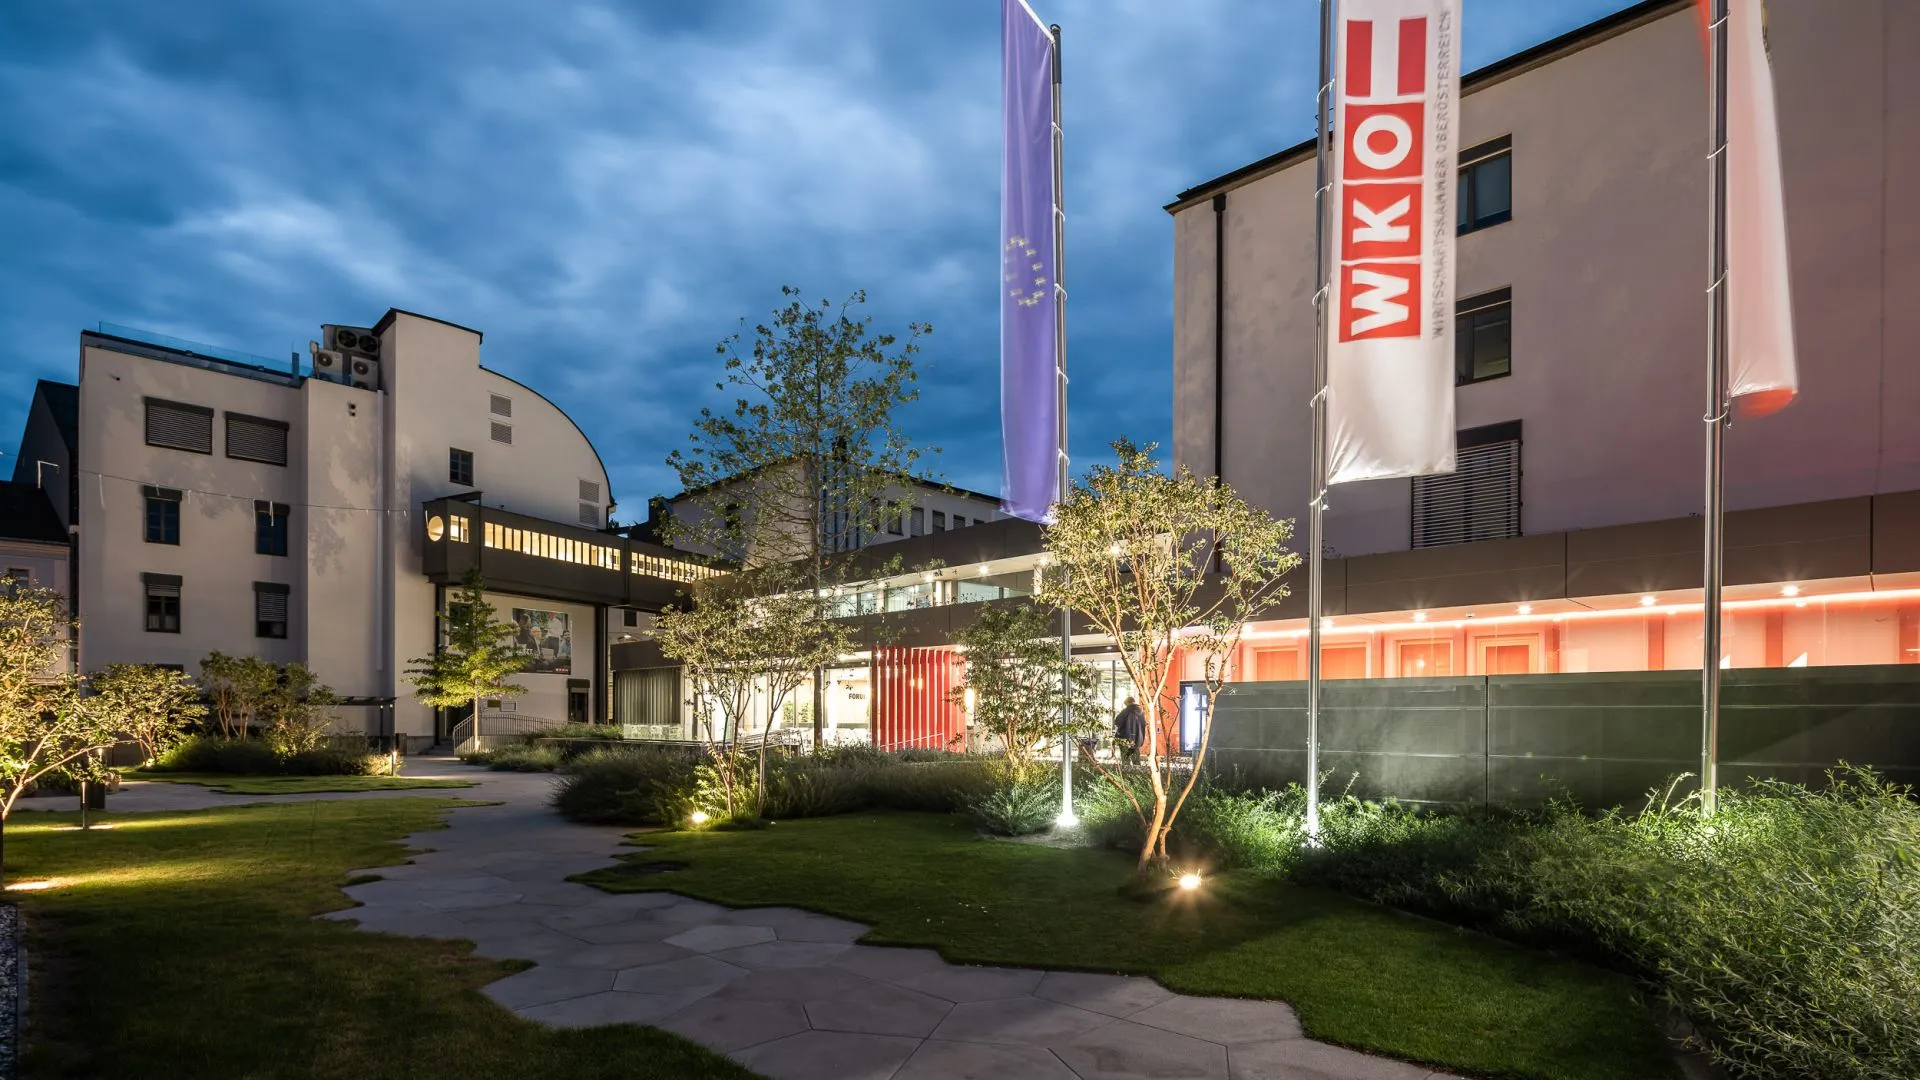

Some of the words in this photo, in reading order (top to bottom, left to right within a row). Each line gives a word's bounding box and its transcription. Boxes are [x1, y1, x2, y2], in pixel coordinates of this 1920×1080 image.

[1435, 11, 1451, 152] OBERÖSTERREICH
[1351, 113, 1412, 336] WKO
[1432, 159, 1447, 339] WIRTSCHAFTSKAMMER
